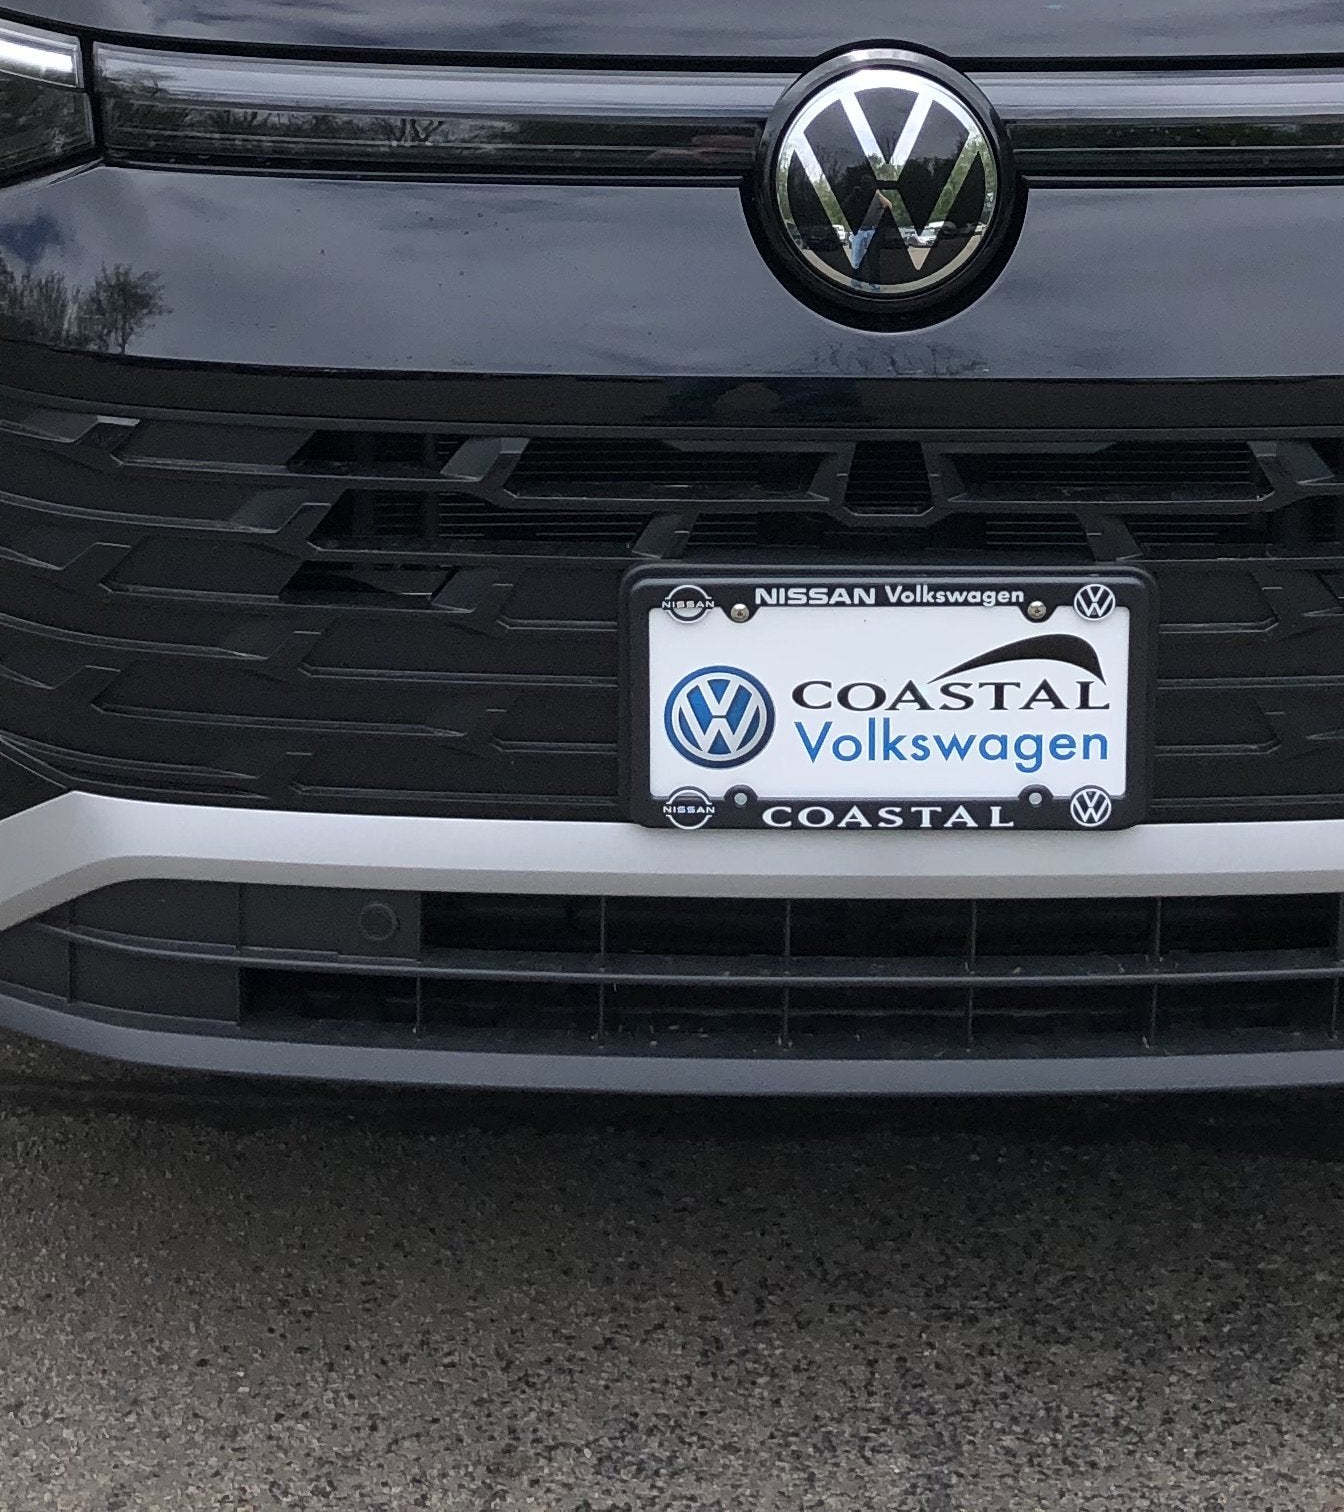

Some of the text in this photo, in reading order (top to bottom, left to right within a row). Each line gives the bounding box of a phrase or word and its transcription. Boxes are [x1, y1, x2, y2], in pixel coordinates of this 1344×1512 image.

[661, 600, 715, 609] NISSAN
[755, 584, 1025, 606] NISSAN Volkswagen
[791, 678, 1110, 711] COASTAL
[794, 717, 1109, 773] Volkswagen
[662, 805, 716, 814] NISSAN
[762, 805, 1014, 828] COASTAL
